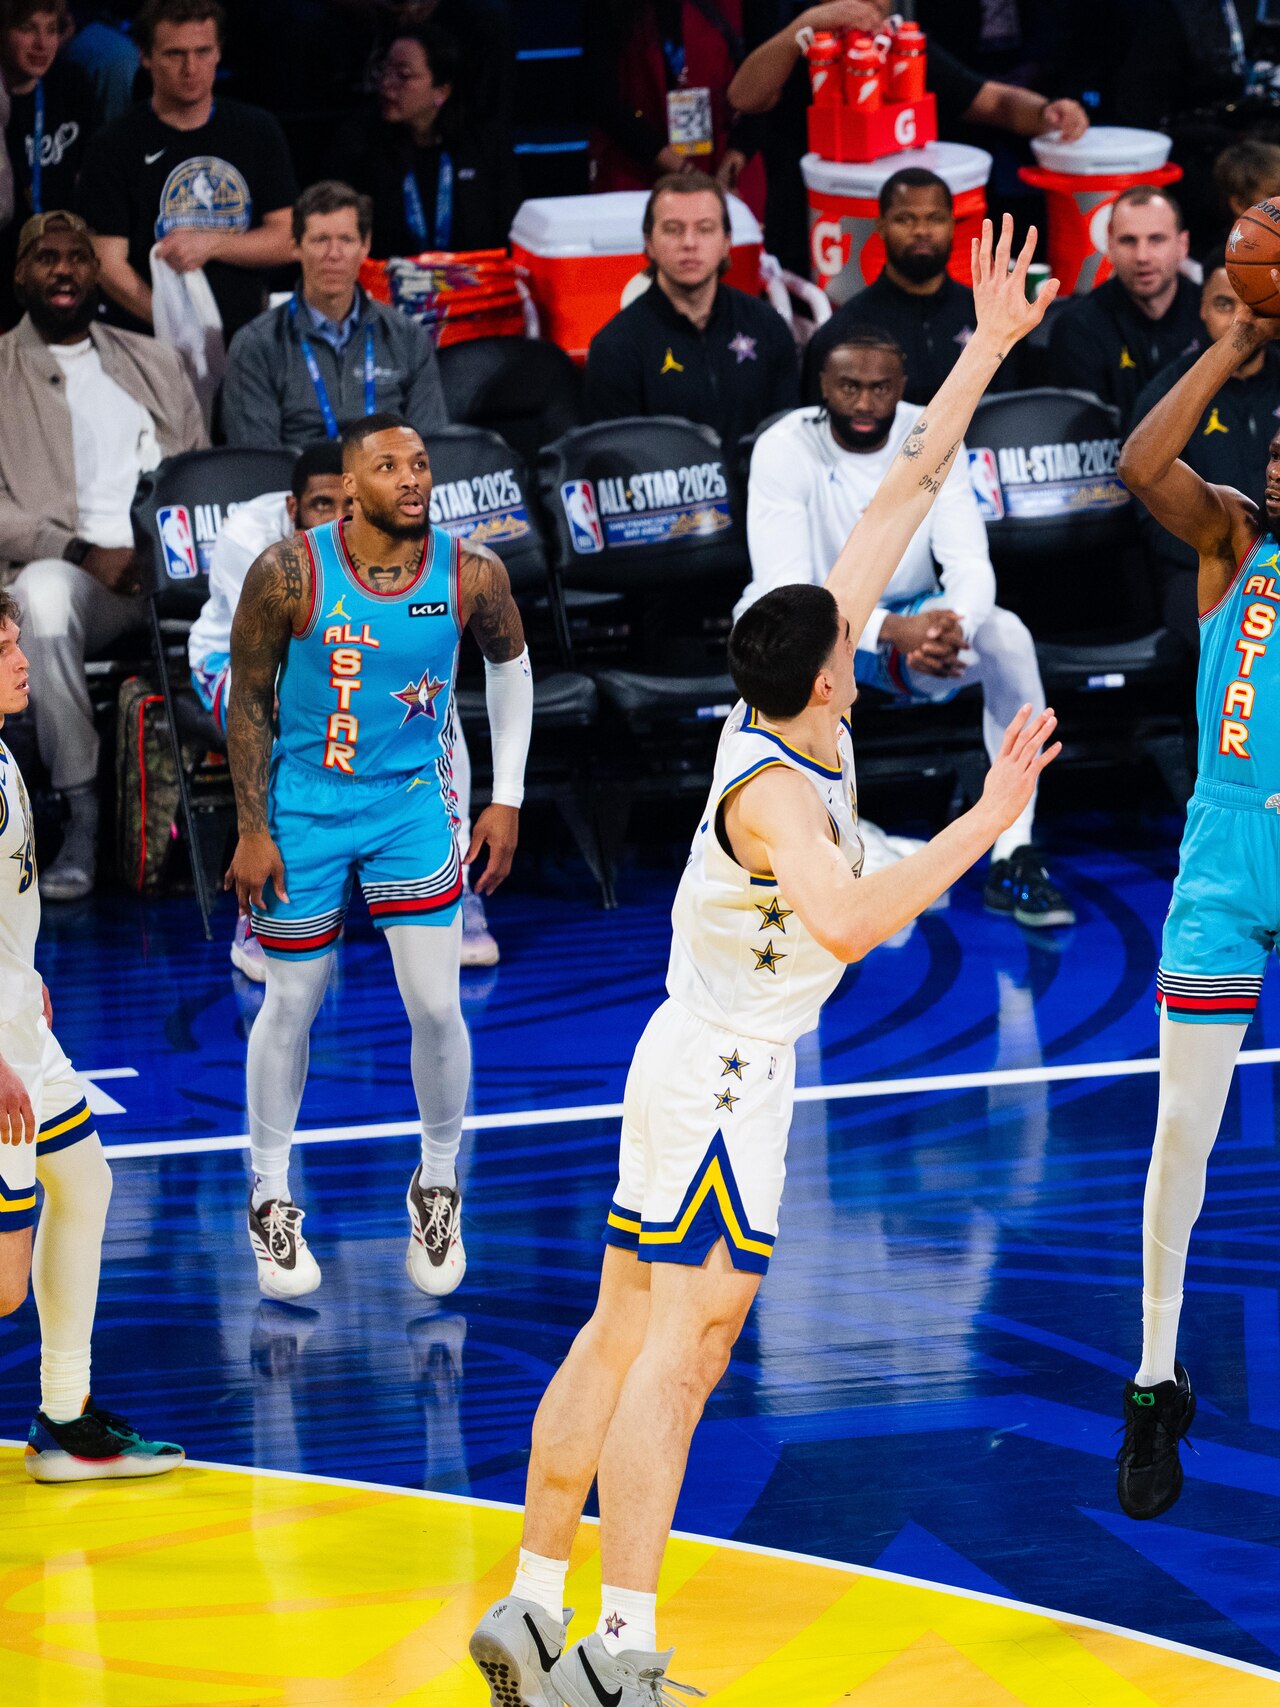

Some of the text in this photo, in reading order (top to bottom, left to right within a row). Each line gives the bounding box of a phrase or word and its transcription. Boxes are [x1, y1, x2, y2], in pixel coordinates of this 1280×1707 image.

[895, 108, 916, 145] G
[812, 221, 843, 275] G
[471, 468, 522, 513] 2025
[323, 624, 380, 648] ALL
[1218, 602, 1278, 759] STAR
[322, 647, 362, 774] STAR
